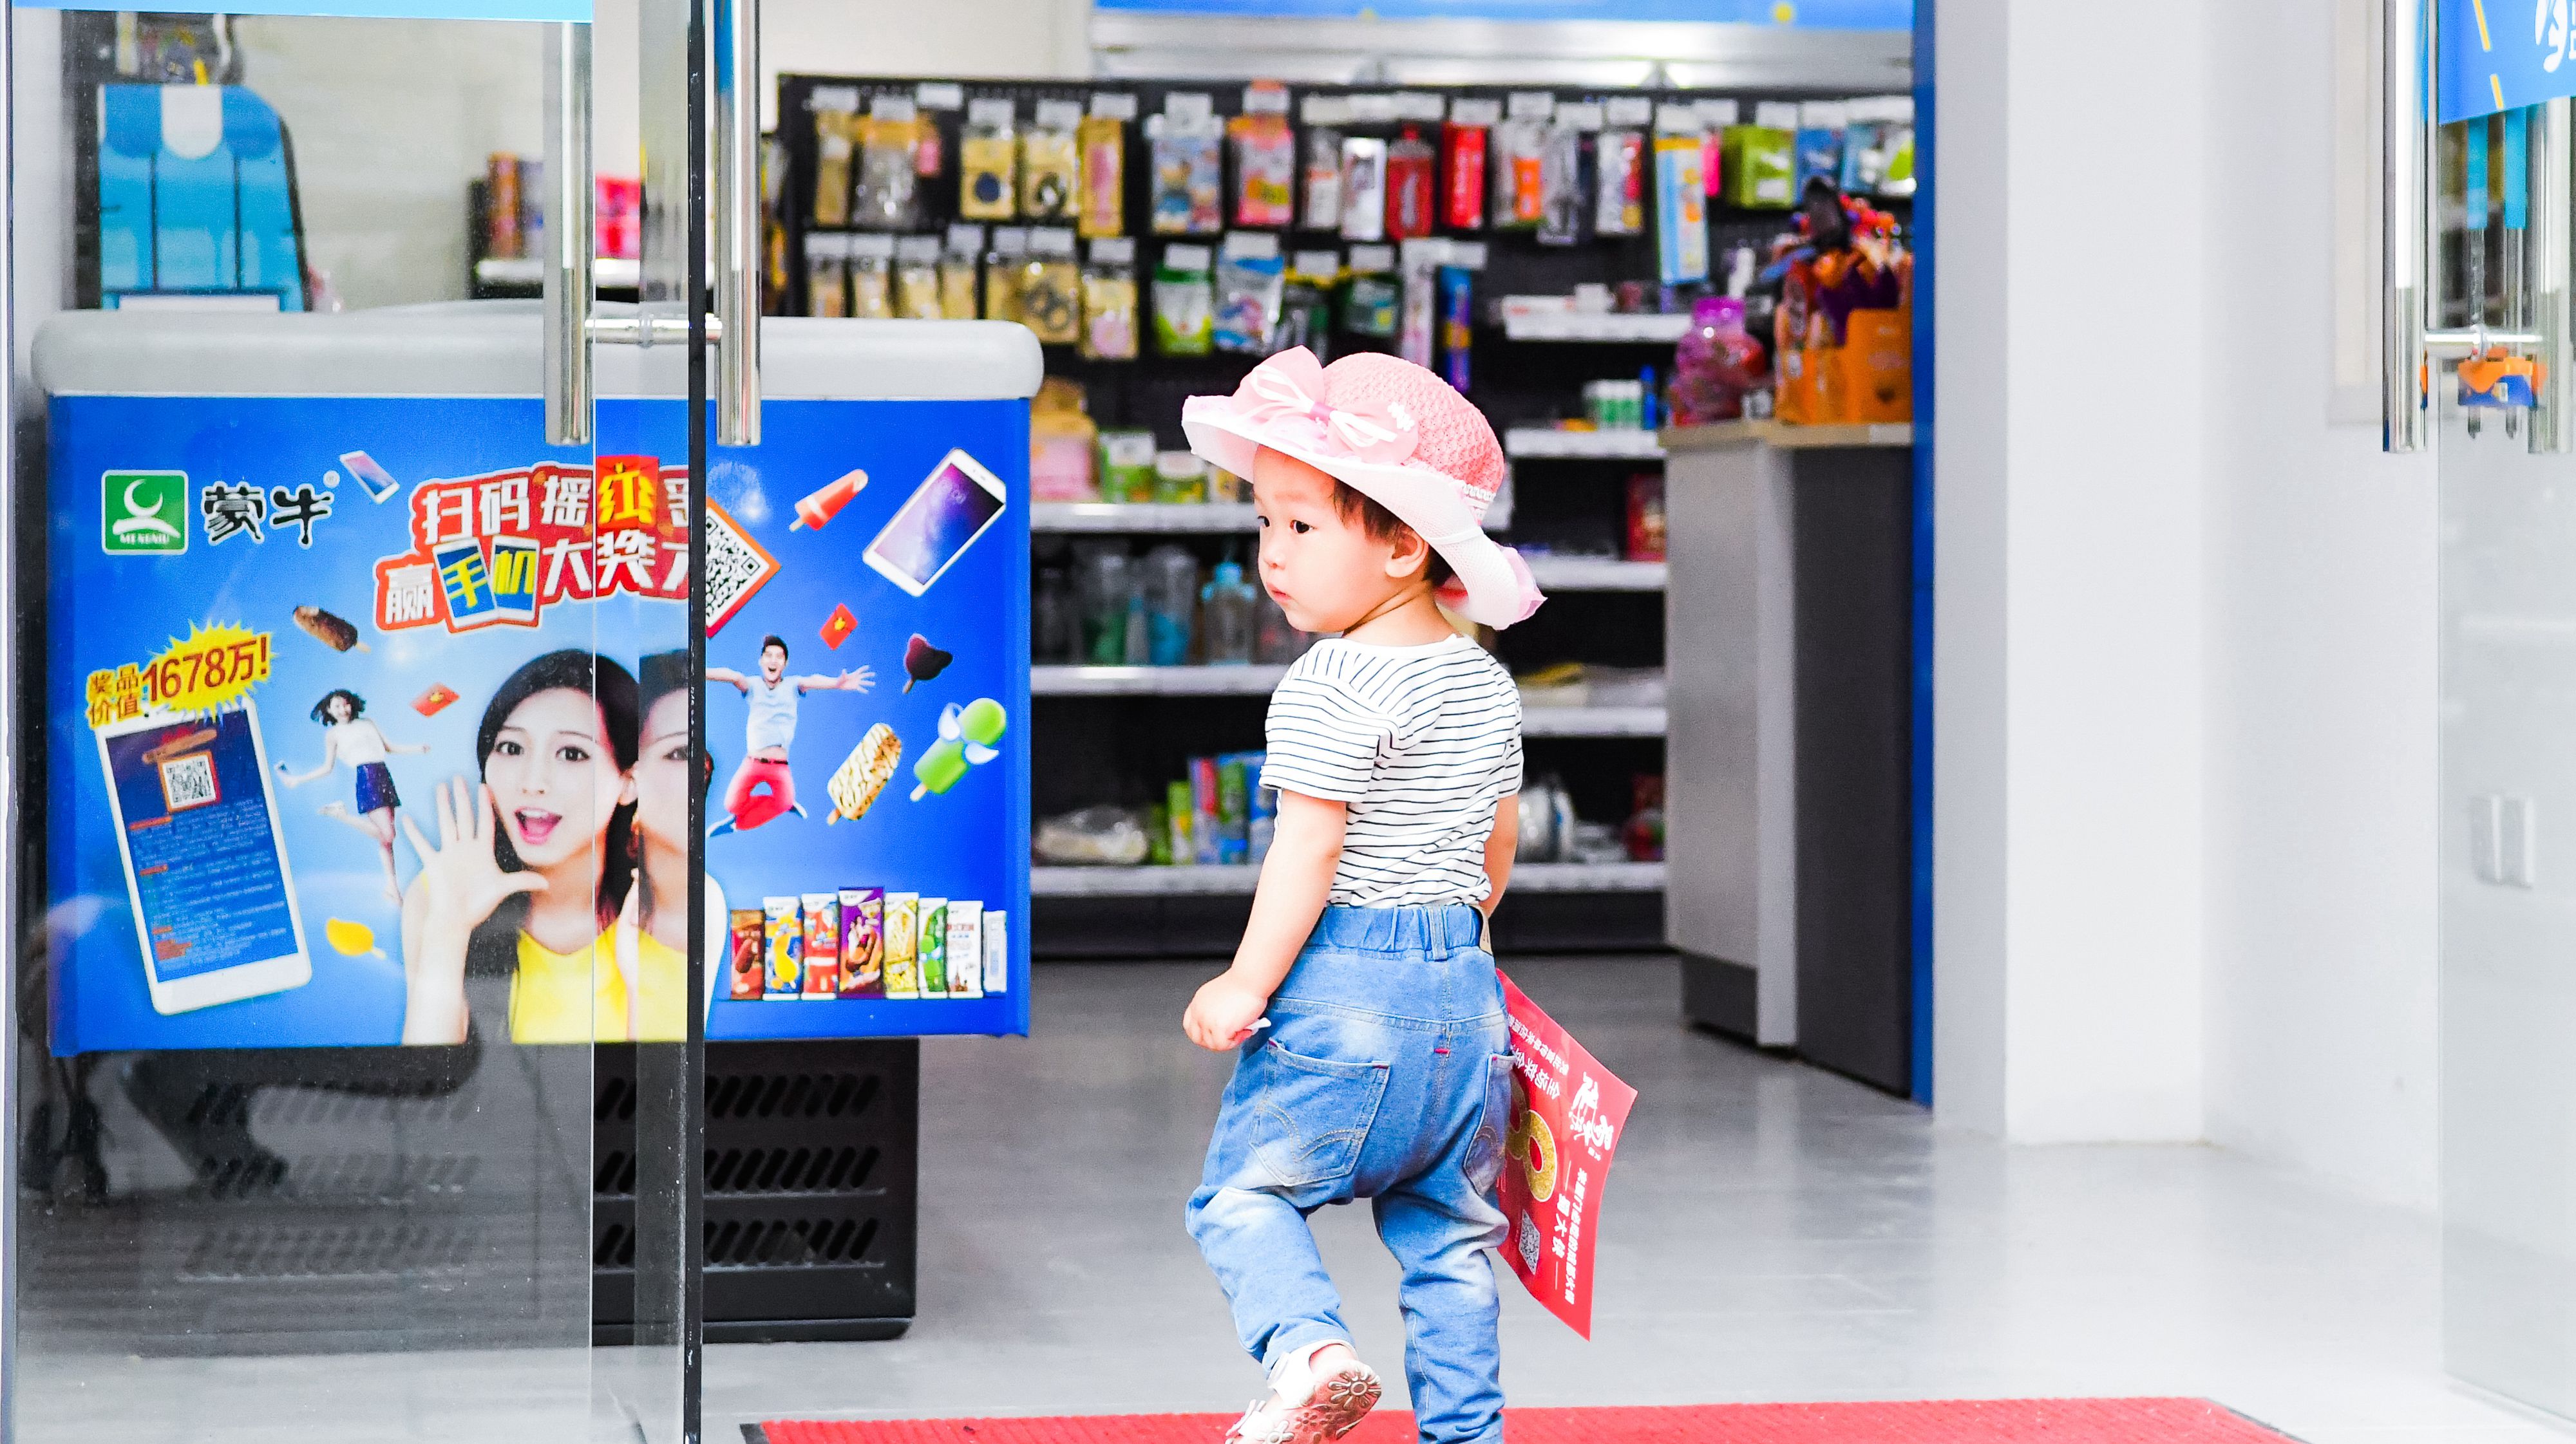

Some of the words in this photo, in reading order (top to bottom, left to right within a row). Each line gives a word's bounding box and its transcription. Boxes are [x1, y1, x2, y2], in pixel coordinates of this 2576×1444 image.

[203, 483, 331, 546] 蒙牛
[142, 636, 267, 702] 1678万!
[90, 693, 138, 725] 价值
[1551, 1193, 1570, 1258] 蜀大侠
